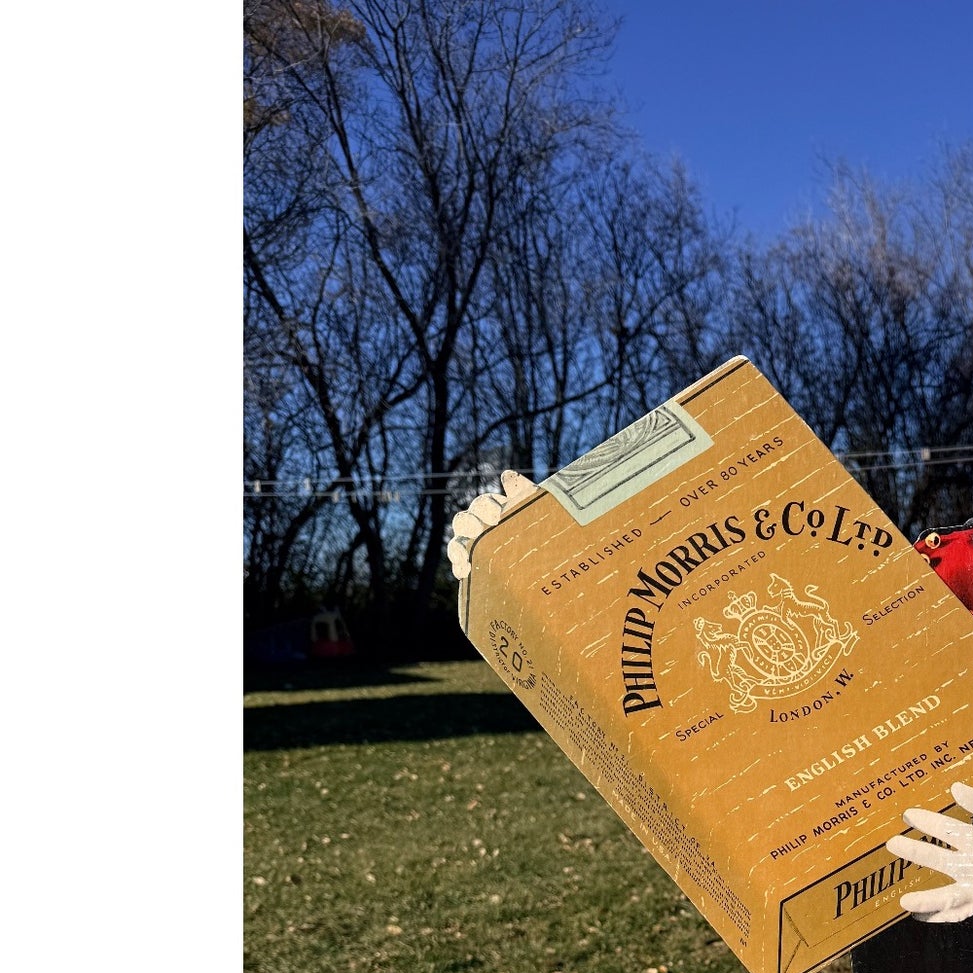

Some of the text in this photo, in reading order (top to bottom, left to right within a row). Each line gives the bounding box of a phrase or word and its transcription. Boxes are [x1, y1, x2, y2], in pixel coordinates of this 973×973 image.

[541, 436, 784, 596] ESTABLISHED OVER 80 YEARS
[754, 508, 777, 540] &
[627, 515, 746, 612] MORRIS
[678, 551, 766, 610] INCORPORATED
[489, 619, 519, 641] FACTORY
[862, 585, 926, 626] SELECTION
[499, 636, 523, 672] 20
[621, 606, 664, 717] PHILIP
[834, 668, 854, 687] W.
[675, 712, 725, 742] SPECIAL
[784, 694, 942, 792] ENGLISH BLEND
[835, 740, 950, 809] MANUFACTURED BY
[769, 834, 808, 861] PHILIP
[812, 806, 859, 837] MORRIS
[876, 787, 896, 801] CO.
[899, 769, 928, 789] LTD.
[931, 753, 956, 770] INC.
[833, 857, 912, 921] PHILIP
[874, 878, 921, 908] ENGLISH
